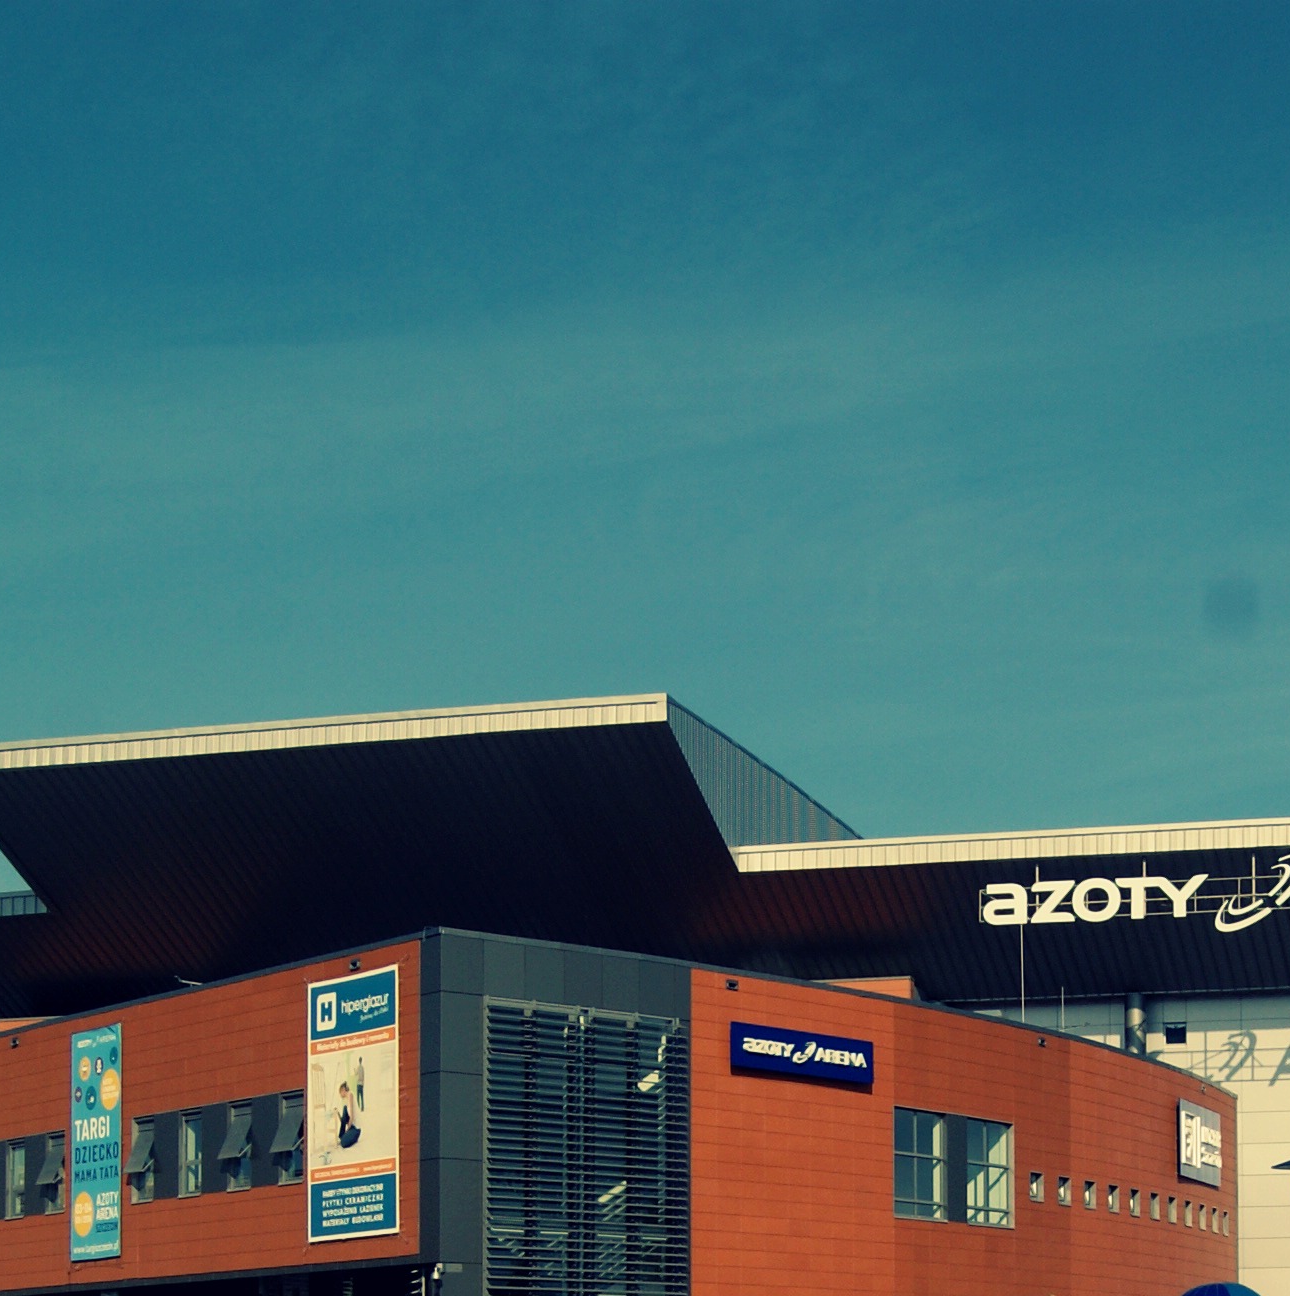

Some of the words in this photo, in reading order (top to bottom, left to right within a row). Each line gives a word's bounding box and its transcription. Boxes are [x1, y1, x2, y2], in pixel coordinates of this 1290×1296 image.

[340, 993, 389, 1016] hiperglazur
[814, 1047, 867, 1068] ARENA
[74, 1115, 110, 1141] TARGI
[75, 1141, 119, 1164] DZIECKO
[74, 1168, 98, 1182] MAMA
[99, 1165, 119, 1180] TATA
[96, 1191, 119, 1206] AZOTY
[96, 1206, 119, 1221] ARENA
